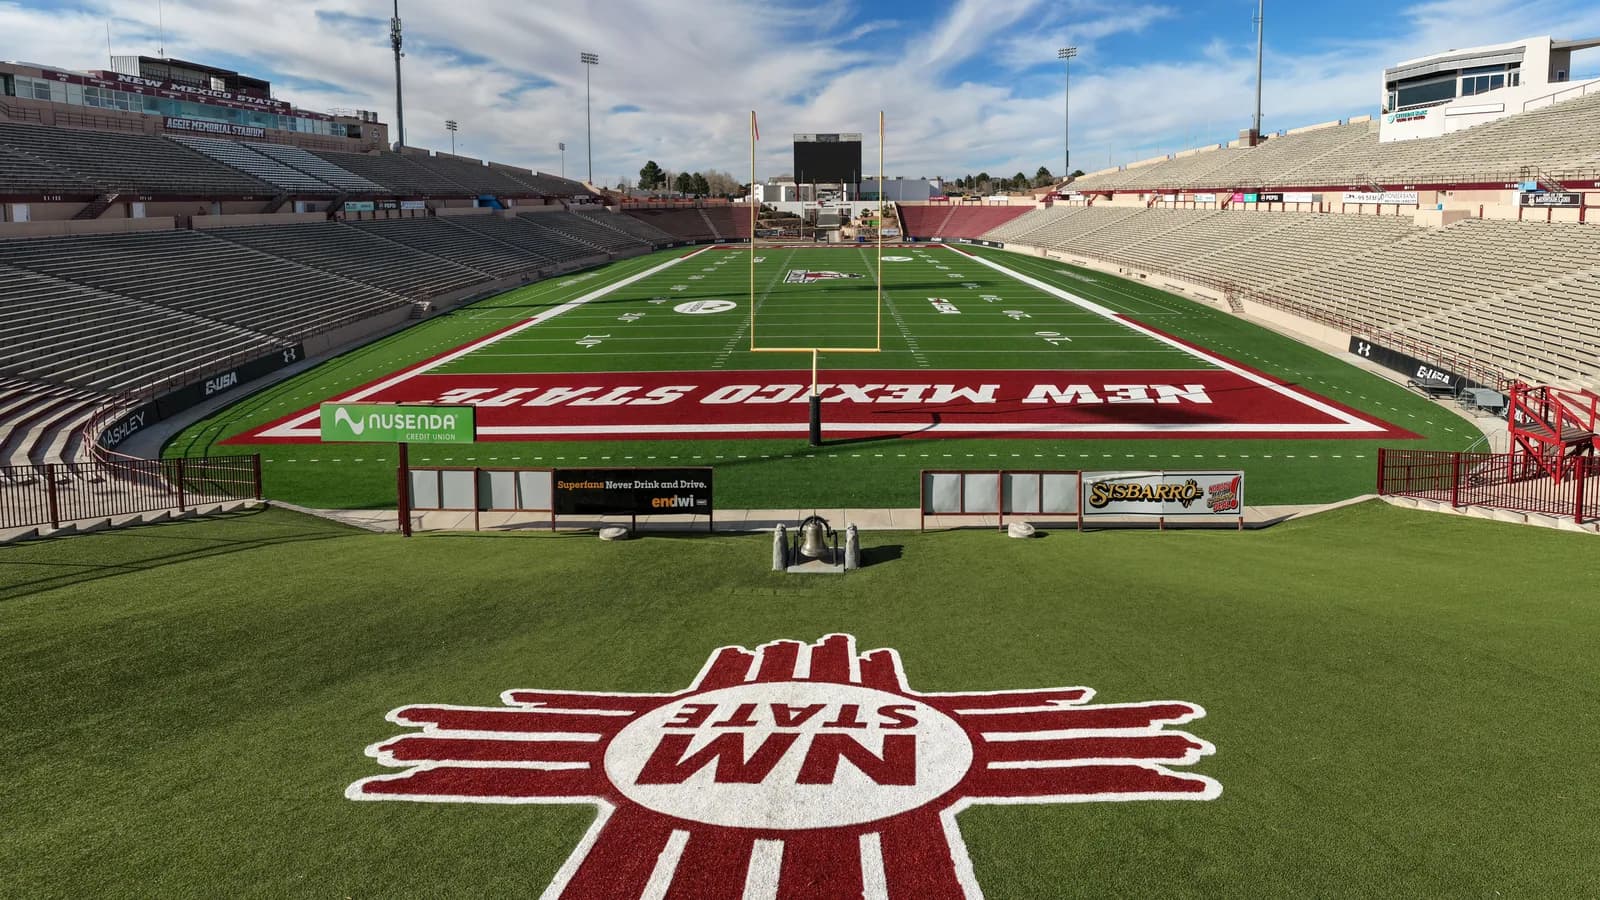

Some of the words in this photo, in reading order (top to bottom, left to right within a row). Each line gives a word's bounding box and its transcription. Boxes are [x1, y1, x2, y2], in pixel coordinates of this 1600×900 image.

[117, 74, 163, 88] NEW
[170, 84, 232, 99] MEXICO
[237, 95, 283, 107] STATE
[167, 117, 190, 130] AGGIE
[191, 121, 232, 135] MEMORIAL
[232, 126, 264, 138] STADIUM
[438, 385, 698, 407] STATE
[699, 384, 1000, 404] MEXICO
[1021, 384, 1213, 404] NEW
[107, 411, 145, 446] ASHLEY
[369, 414, 456, 430] NUSENDA
[432, 433, 456, 441] UNION
[557, 480, 604, 490] Superfans
[605, 480, 632, 489] Never
[634, 480, 660, 489] Drink
[661, 480, 679, 489] and
[680, 480, 707, 489] Drive.
[1089, 481, 1204, 509] SISBARRO
[651, 494, 694, 508] endwi
[662, 703, 919, 729] STATE
[634, 732, 917, 786] NM
